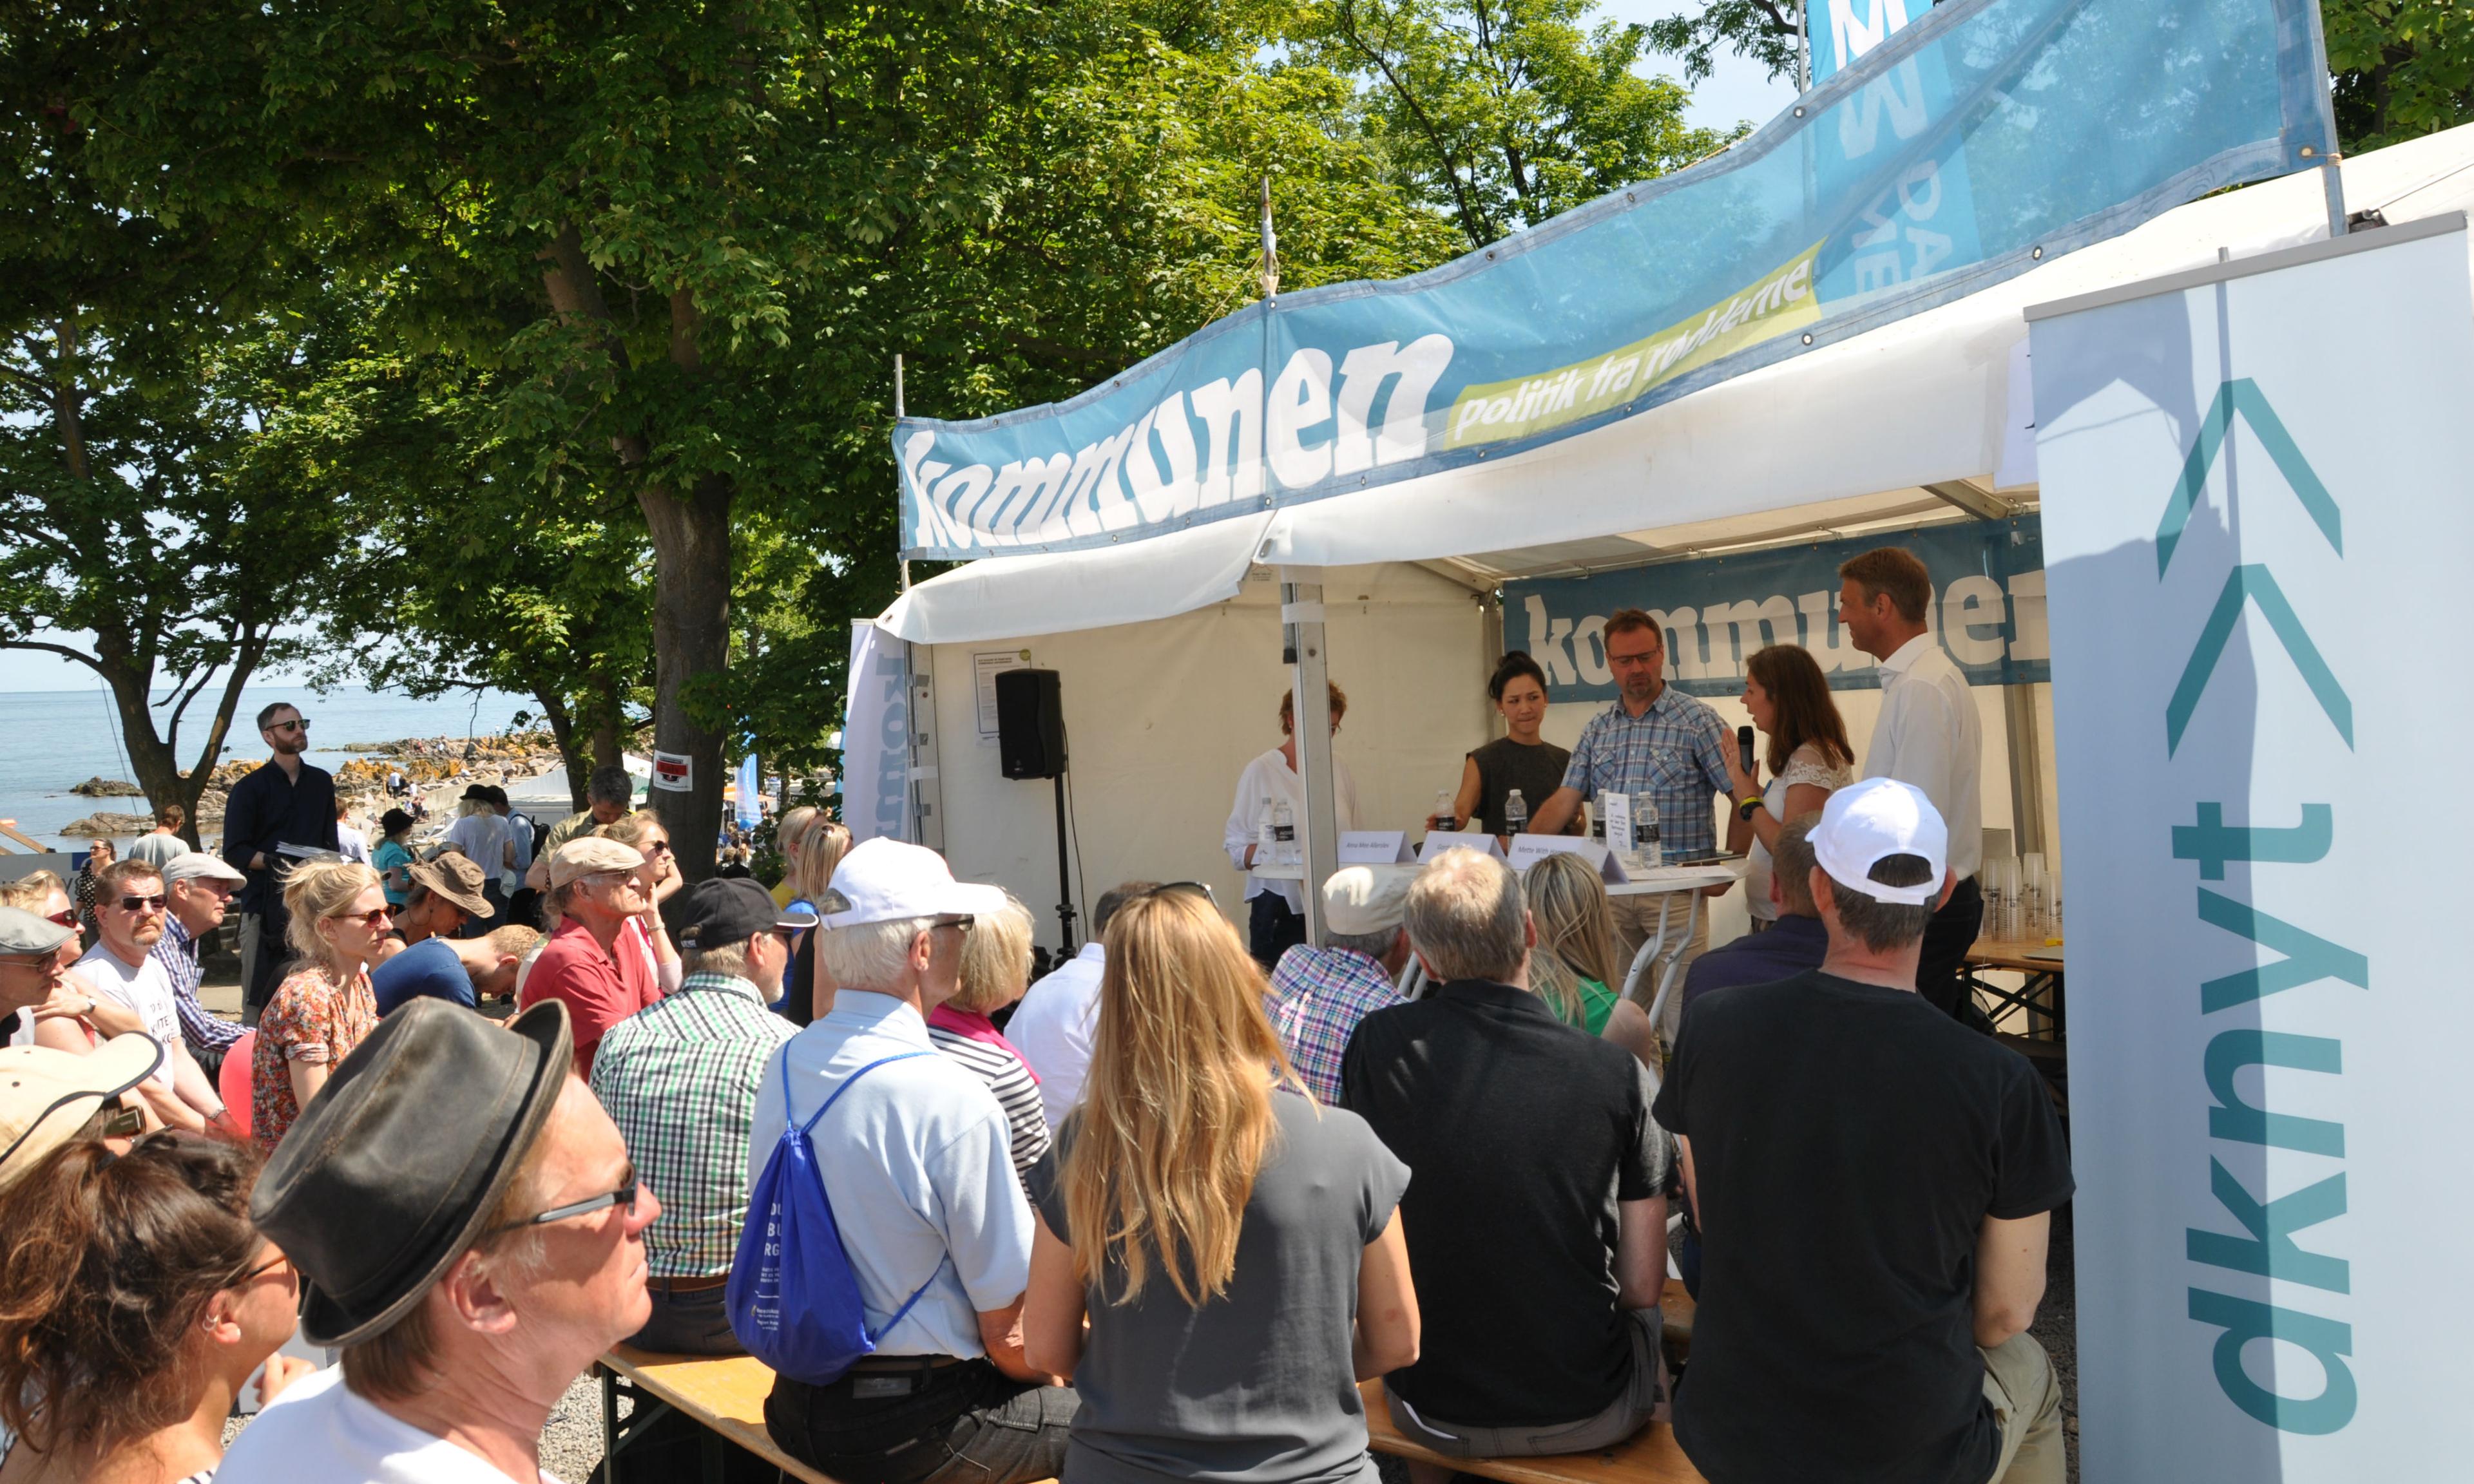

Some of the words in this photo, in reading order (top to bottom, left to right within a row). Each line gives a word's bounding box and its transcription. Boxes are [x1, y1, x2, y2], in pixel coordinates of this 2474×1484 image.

[904, 333, 1454, 550] kommunen
[1453, 367, 1585, 441] politik
[1586, 355, 1641, 402] fra
[1643, 259, 1811, 381] rødderne
[2171, 801, 2370, 1436] dknyt
